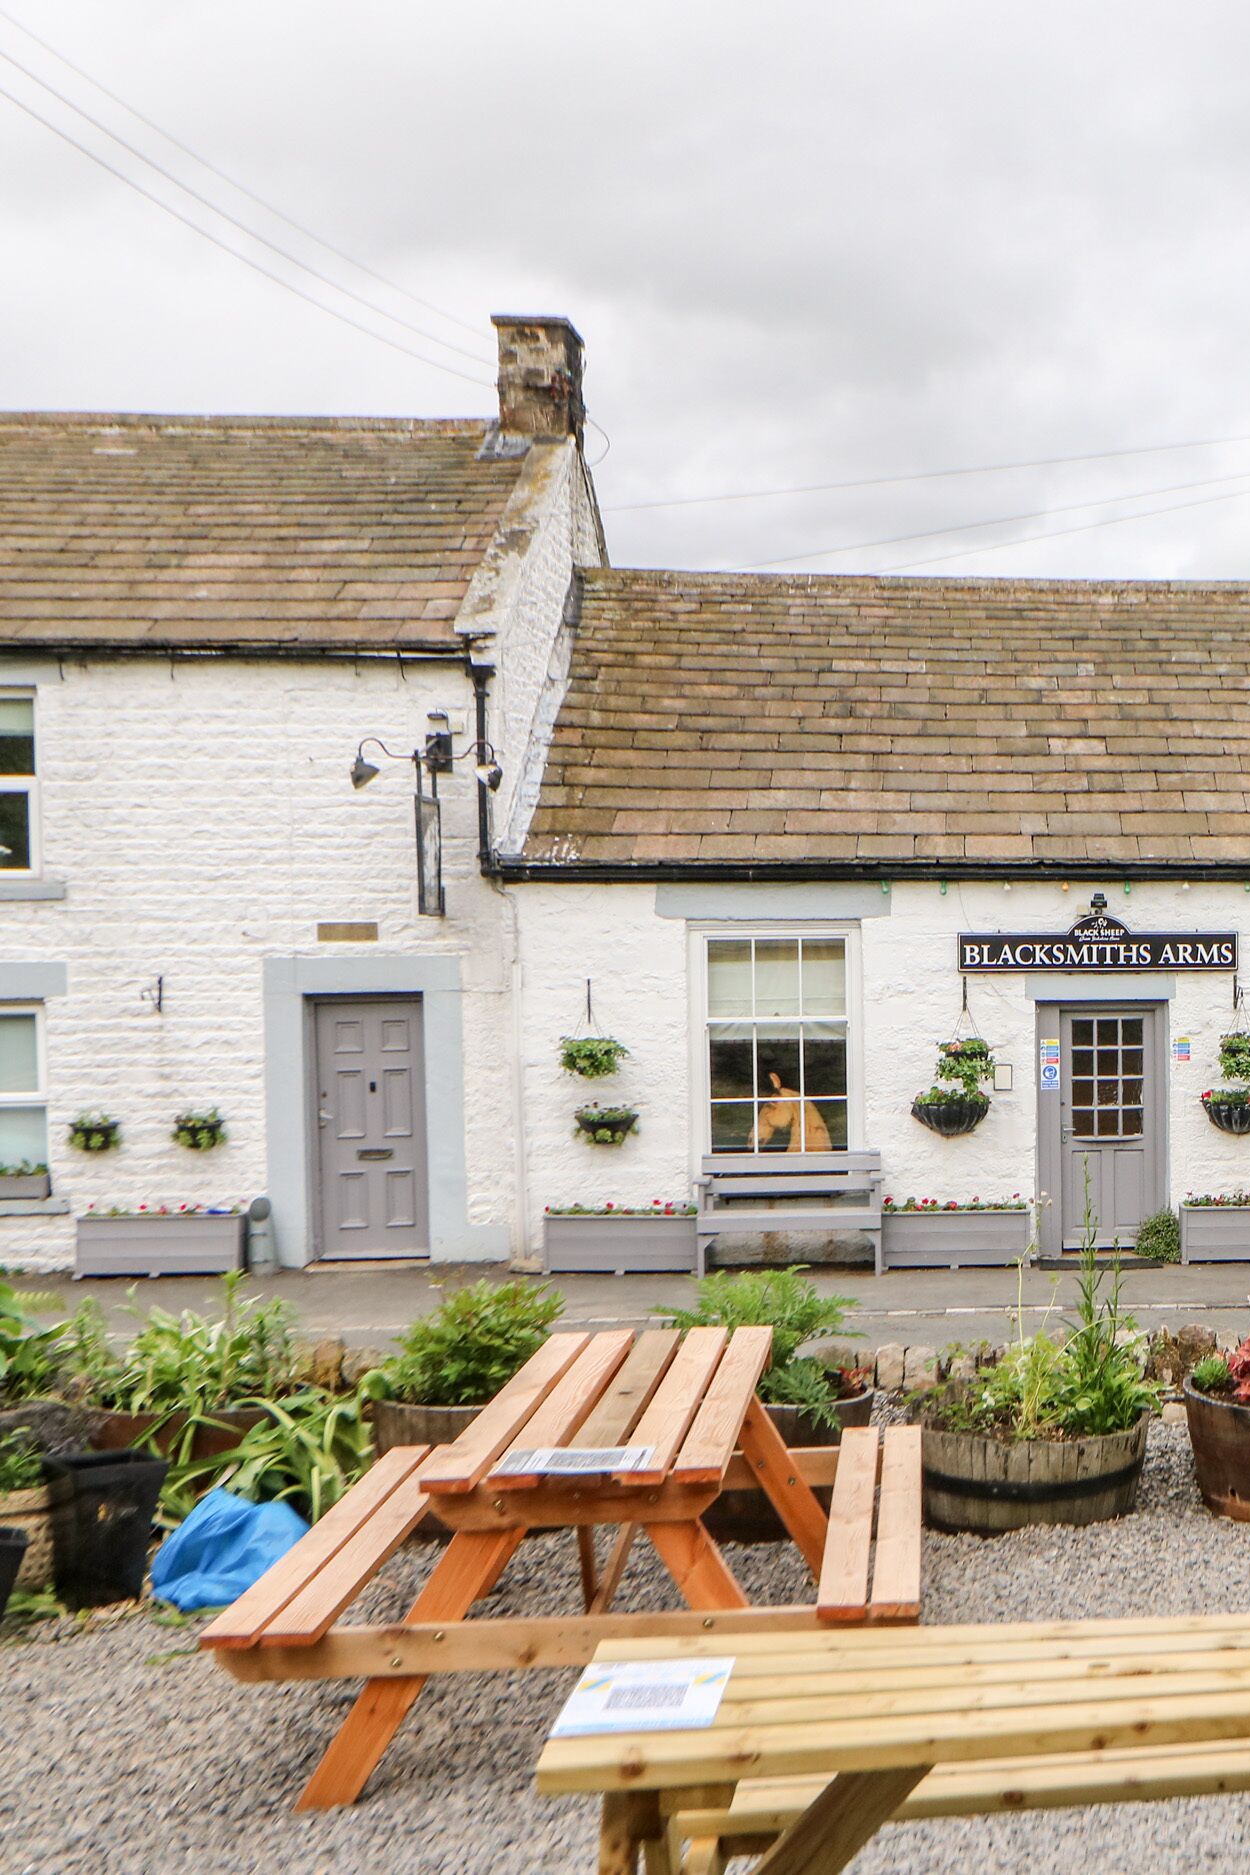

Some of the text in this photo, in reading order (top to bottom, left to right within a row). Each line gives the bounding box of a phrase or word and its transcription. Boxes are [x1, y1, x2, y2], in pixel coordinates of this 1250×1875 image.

[1074, 928, 1125, 936] BLACK SHEEP
[963, 943, 1233, 966] BLACKSMITHS ARMS
